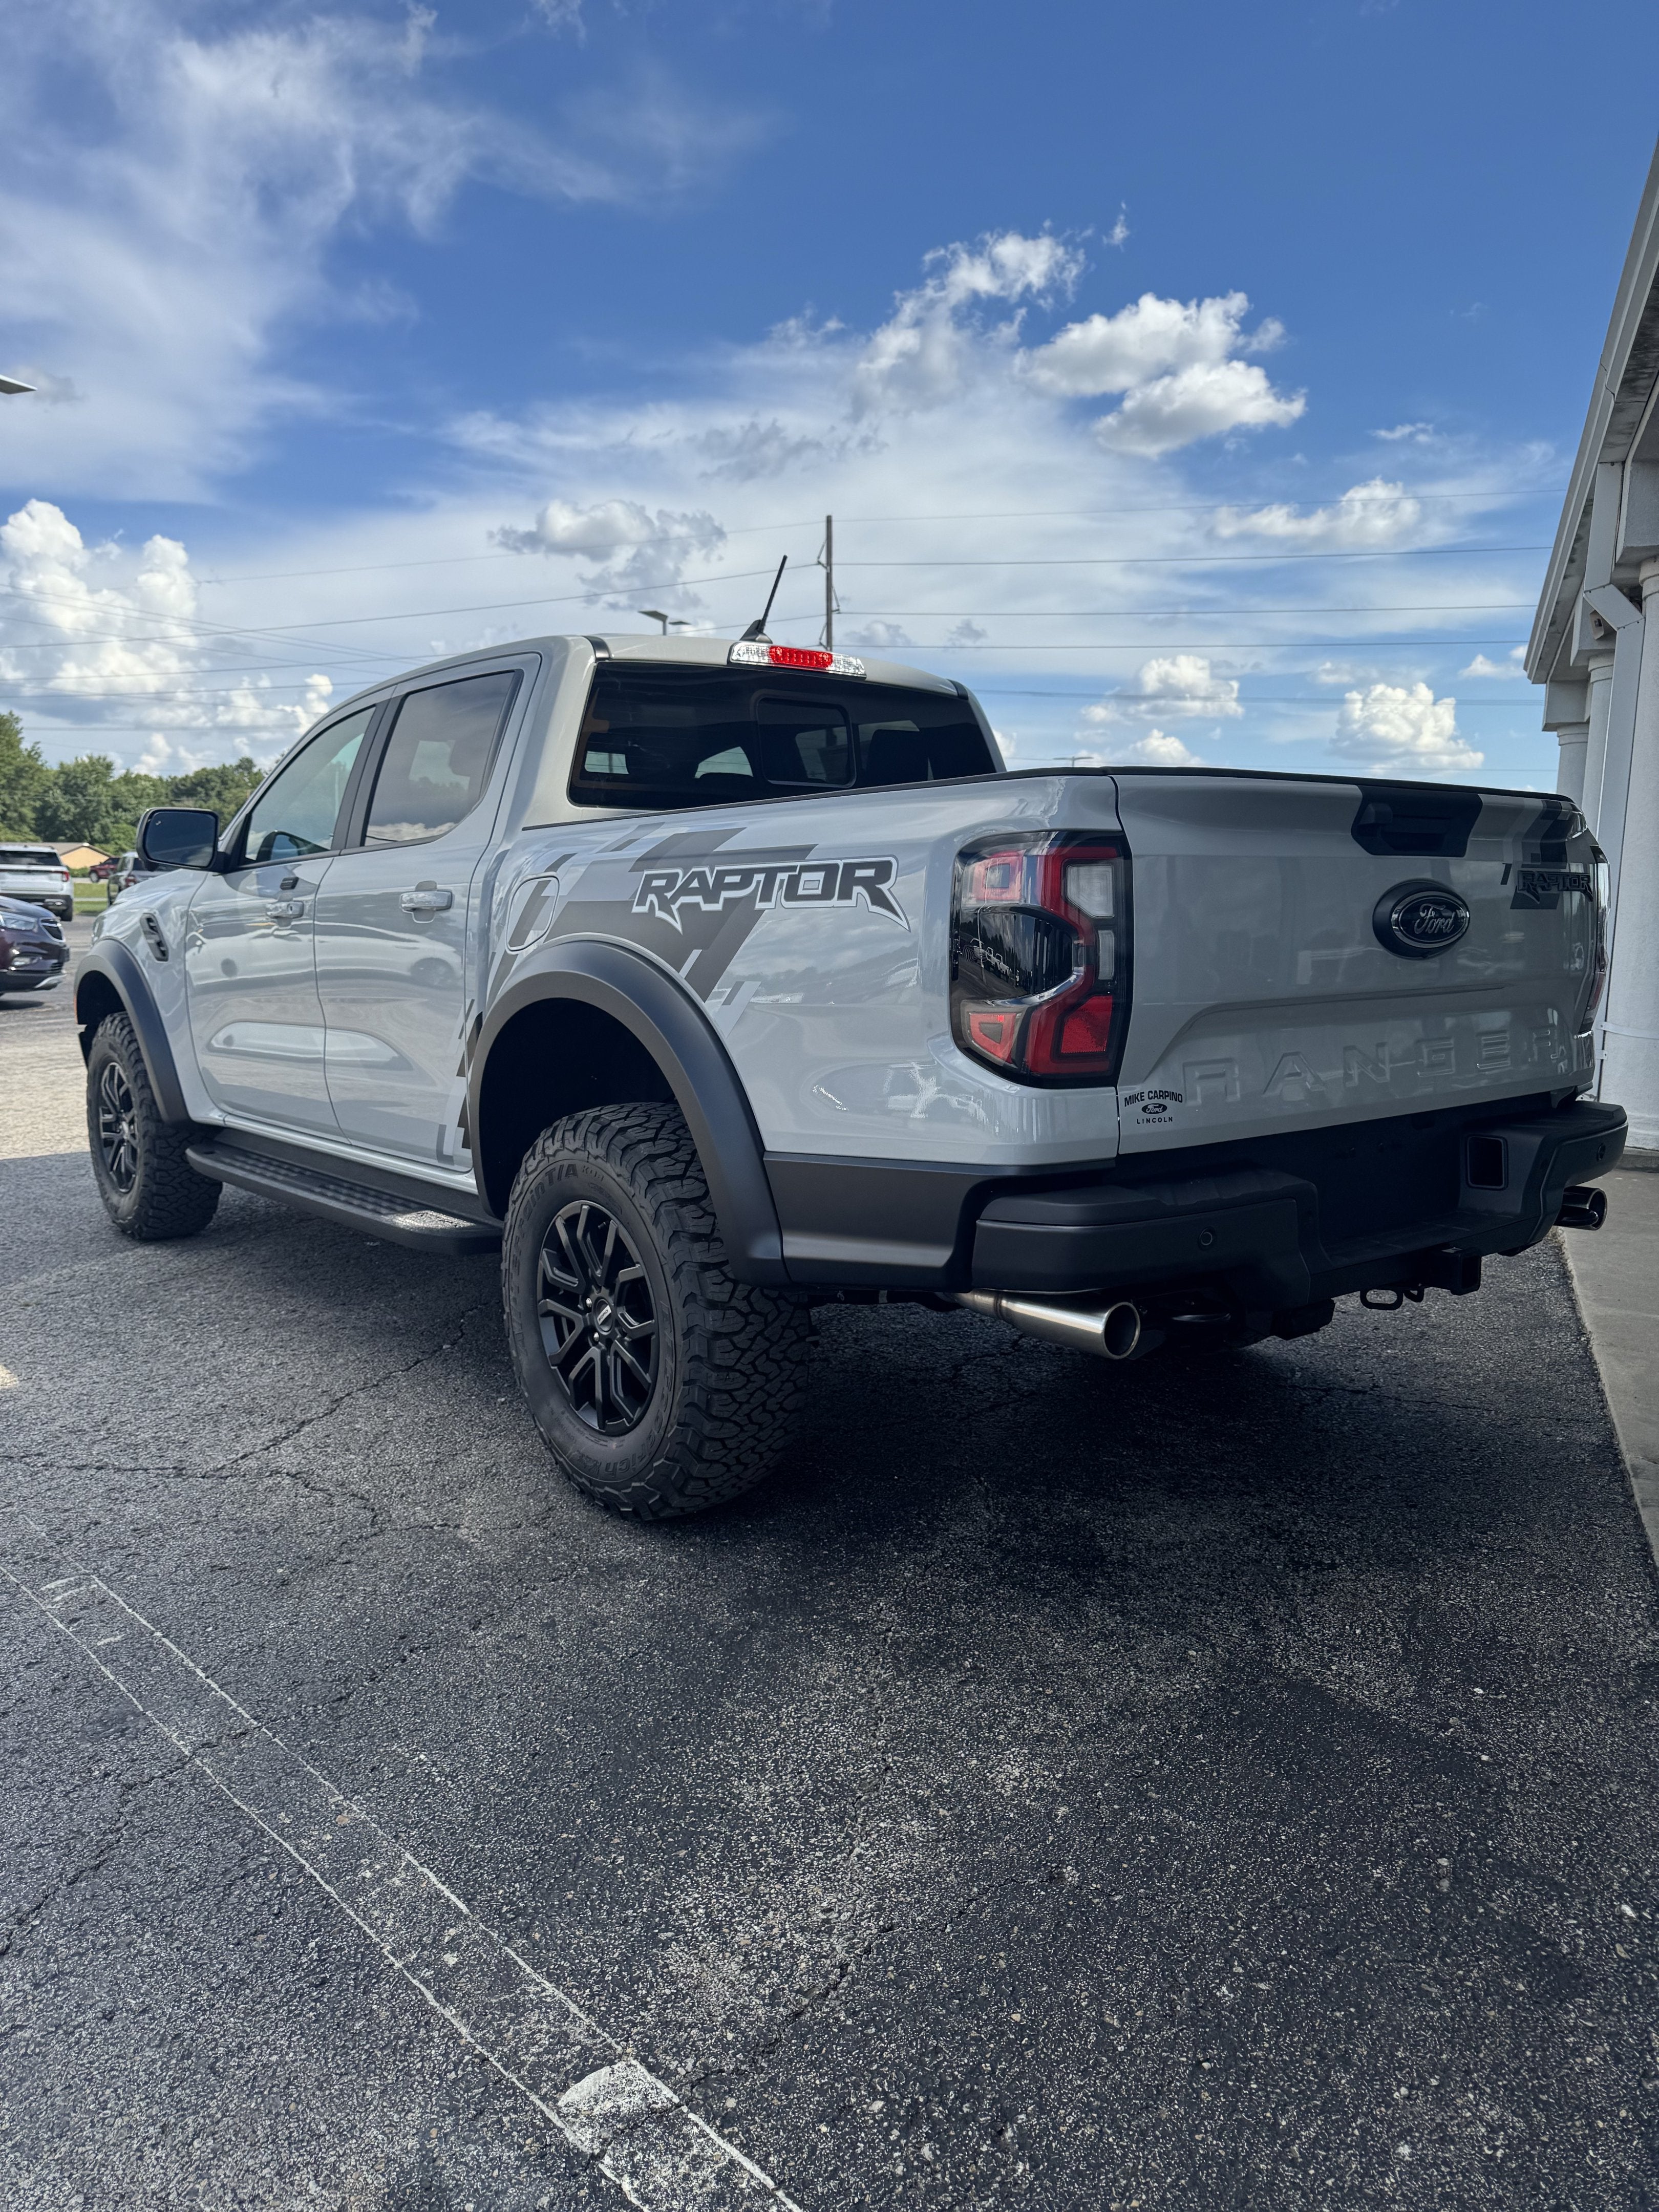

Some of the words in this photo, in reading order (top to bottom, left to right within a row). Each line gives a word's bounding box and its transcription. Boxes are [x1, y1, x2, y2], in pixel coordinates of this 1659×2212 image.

[631, 855, 911, 935] RAPTOR
[1517, 870, 1593, 904] RAPTOR
[1414, 903, 1455, 934] Ford
[1124, 1091, 1145, 1107] MIKE
[1147, 1090, 1183, 1103] CARPINO
[1137, 1116, 1173, 1124] LINCOLN
